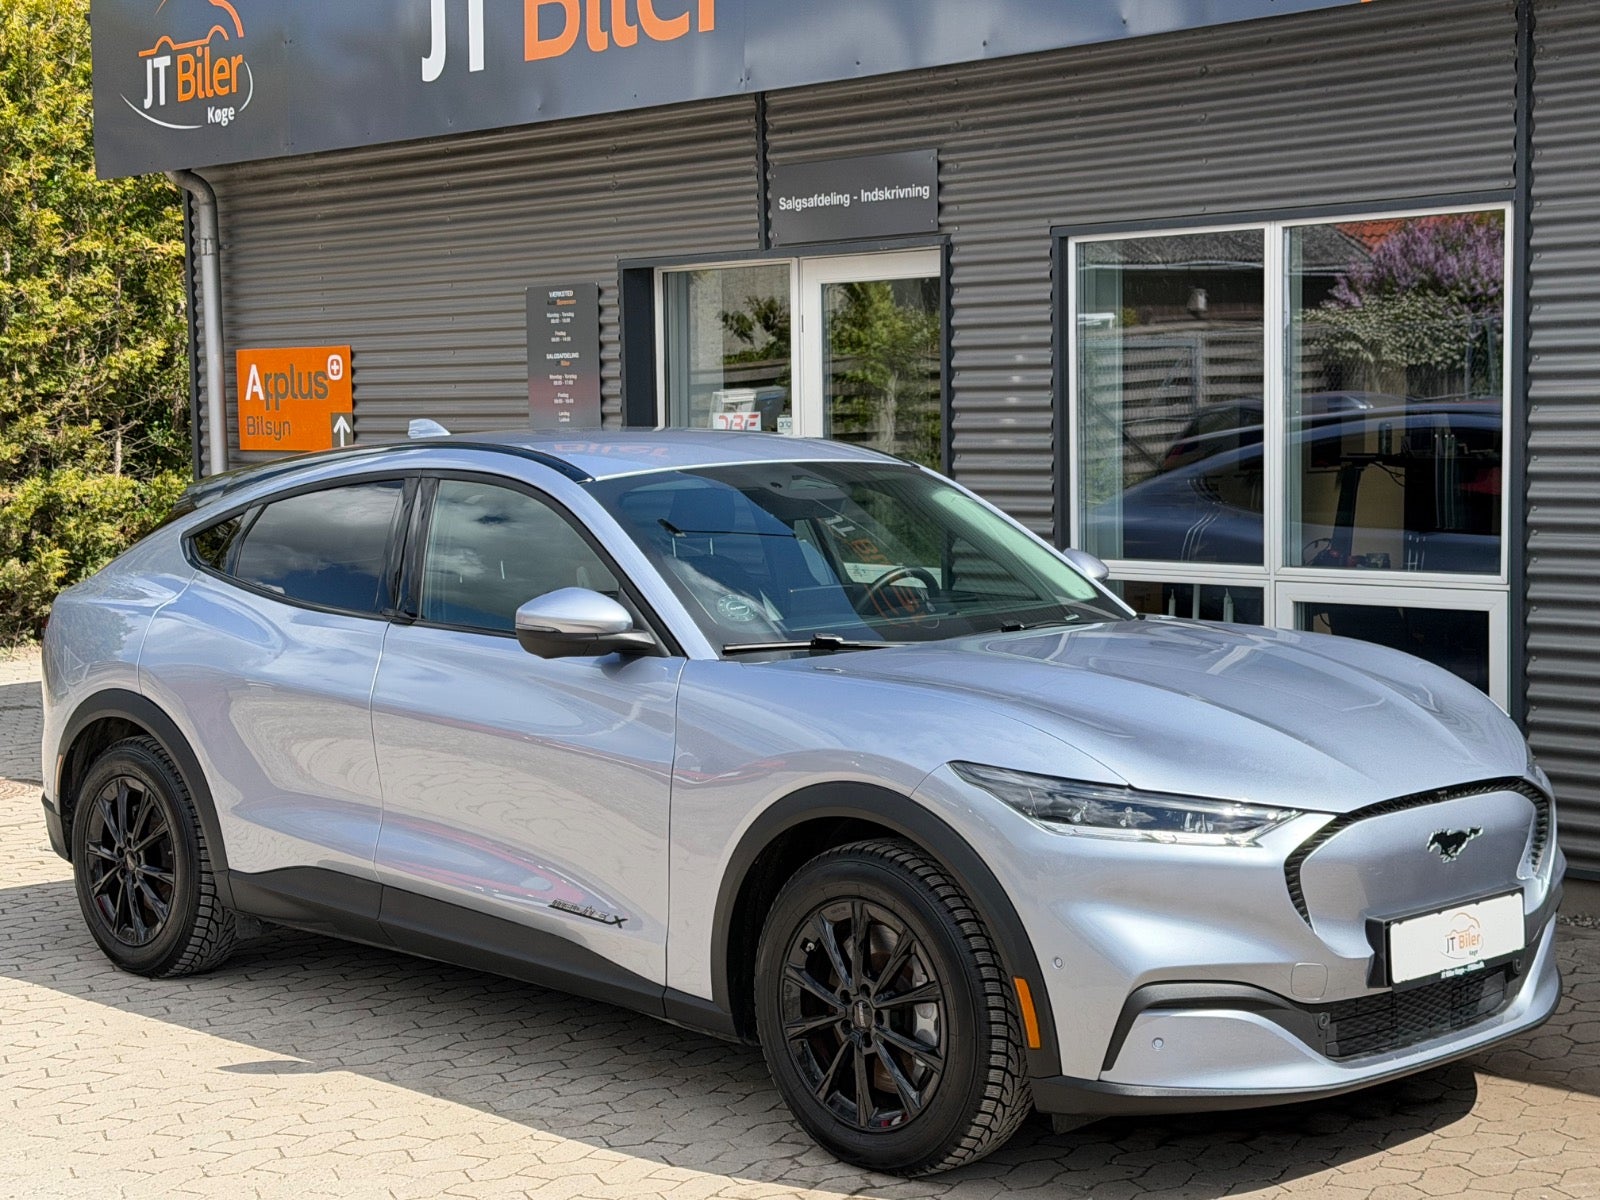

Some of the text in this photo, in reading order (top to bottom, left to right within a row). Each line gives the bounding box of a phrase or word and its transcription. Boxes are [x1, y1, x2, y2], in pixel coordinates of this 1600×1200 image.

[143, 46, 243, 110] JT Biler
[207, 105, 235, 127] Køge
[778, 193, 850, 212] Salgsafdeling
[861, 183, 930, 203] Indskrivning
[246, 416, 291, 441] Bilsyn
[1459, 932, 1481, 949] Biler
